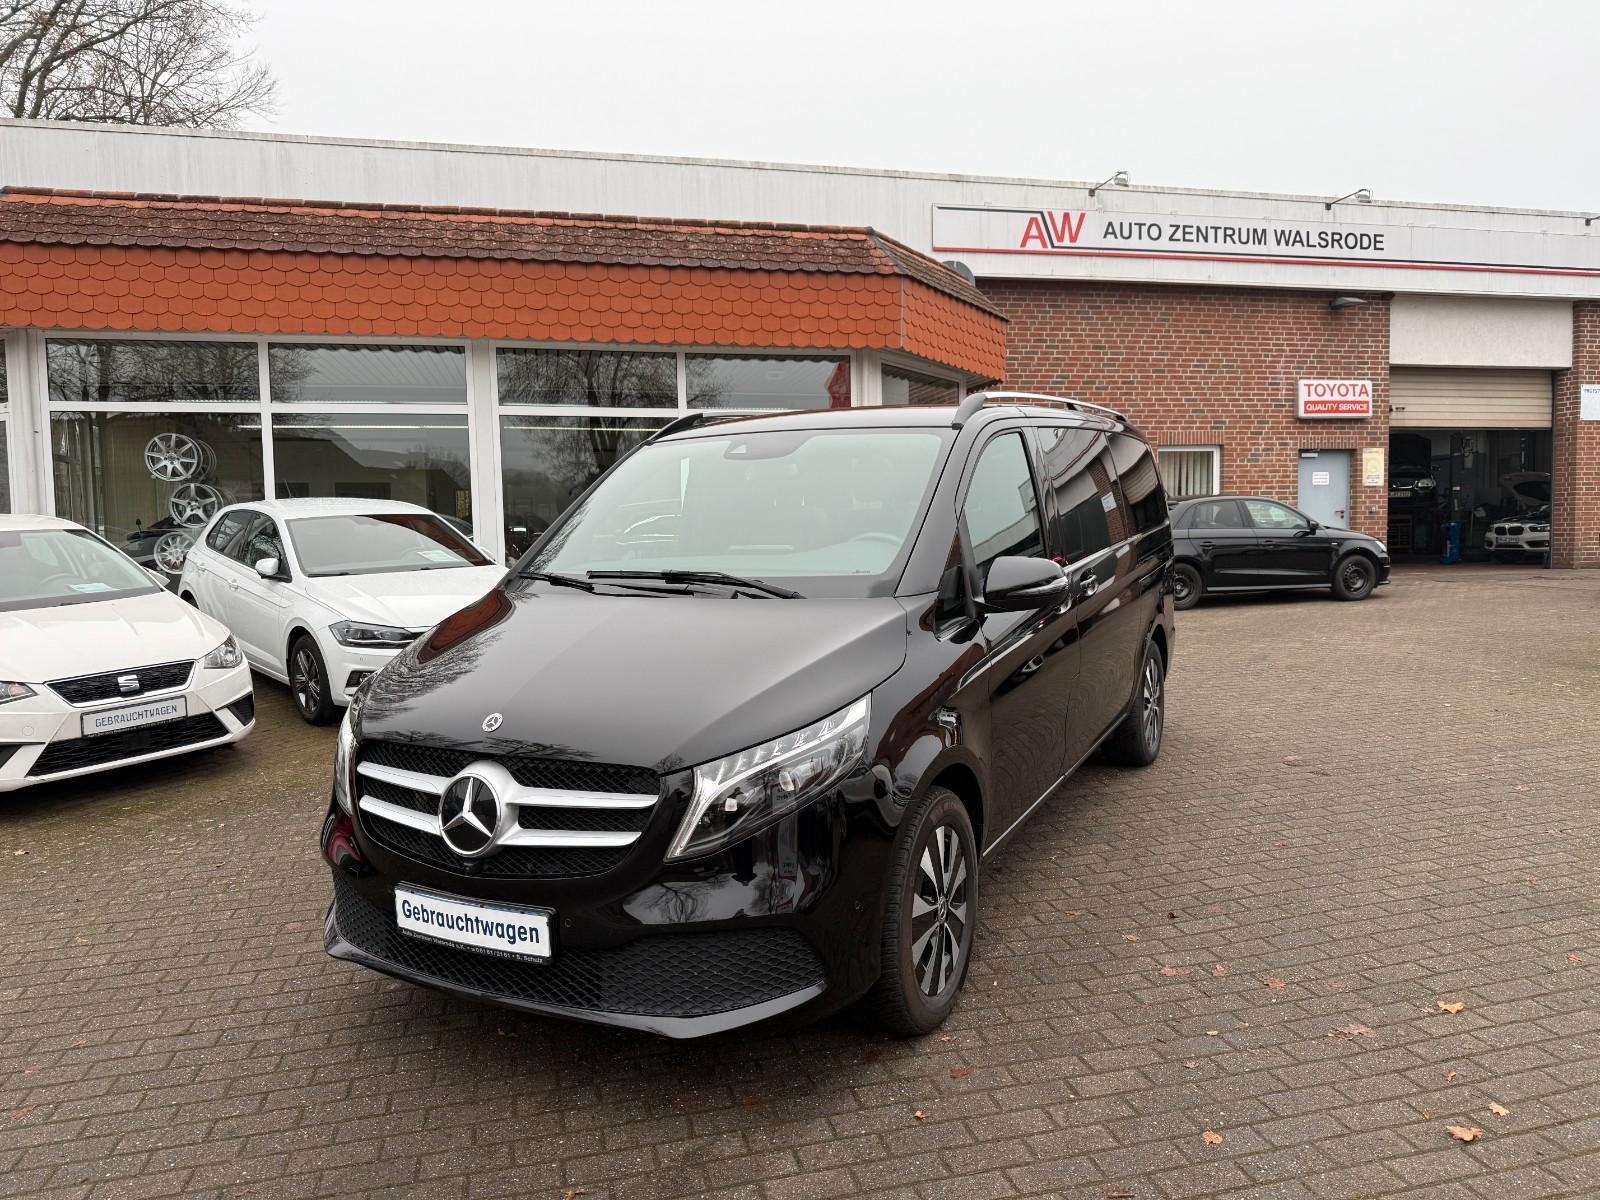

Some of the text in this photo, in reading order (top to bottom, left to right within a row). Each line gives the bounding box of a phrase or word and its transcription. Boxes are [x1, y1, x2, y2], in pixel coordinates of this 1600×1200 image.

[1103, 221, 1385, 251] AUTO ZENTRUM WALSRODE
[1304, 383, 1369, 398] TOYOTA
[1306, 403, 1368, 411] QUALITY SERVICE
[95, 705, 177, 728] GEBRAUCHTWAGEN
[402, 899, 540, 945] Gebrauchtwagen
